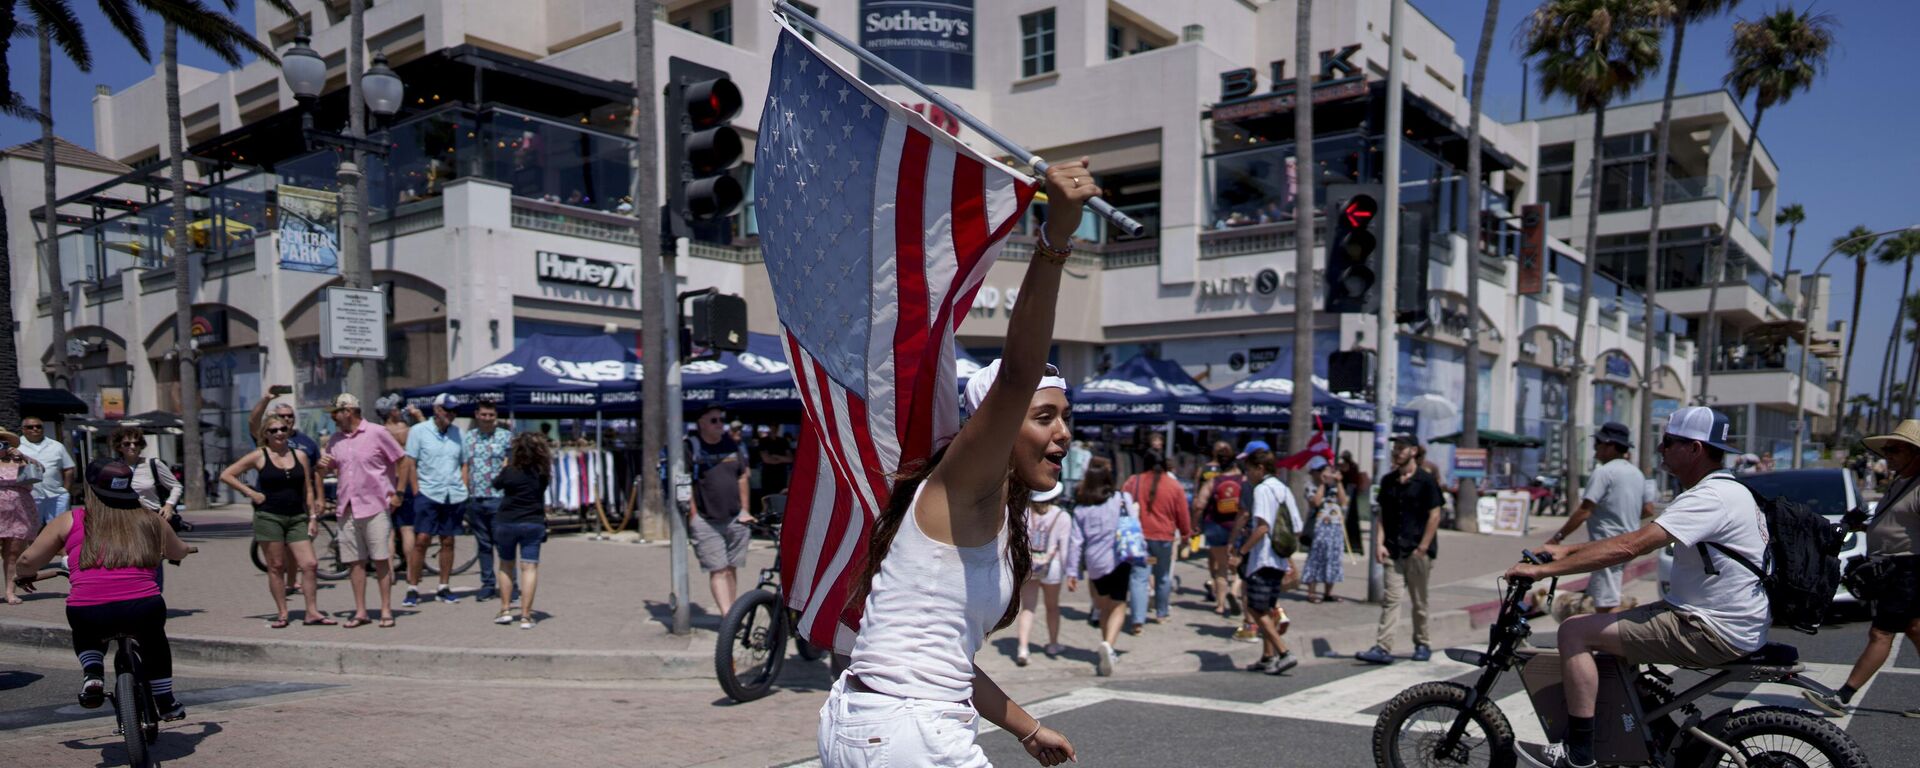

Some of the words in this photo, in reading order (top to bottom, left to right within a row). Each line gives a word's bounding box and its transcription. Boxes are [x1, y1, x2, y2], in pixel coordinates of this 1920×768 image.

[866, 9, 969, 38] Sotheby's
[280, 243, 322, 264] PARK
[539, 252, 615, 288] Hurley
